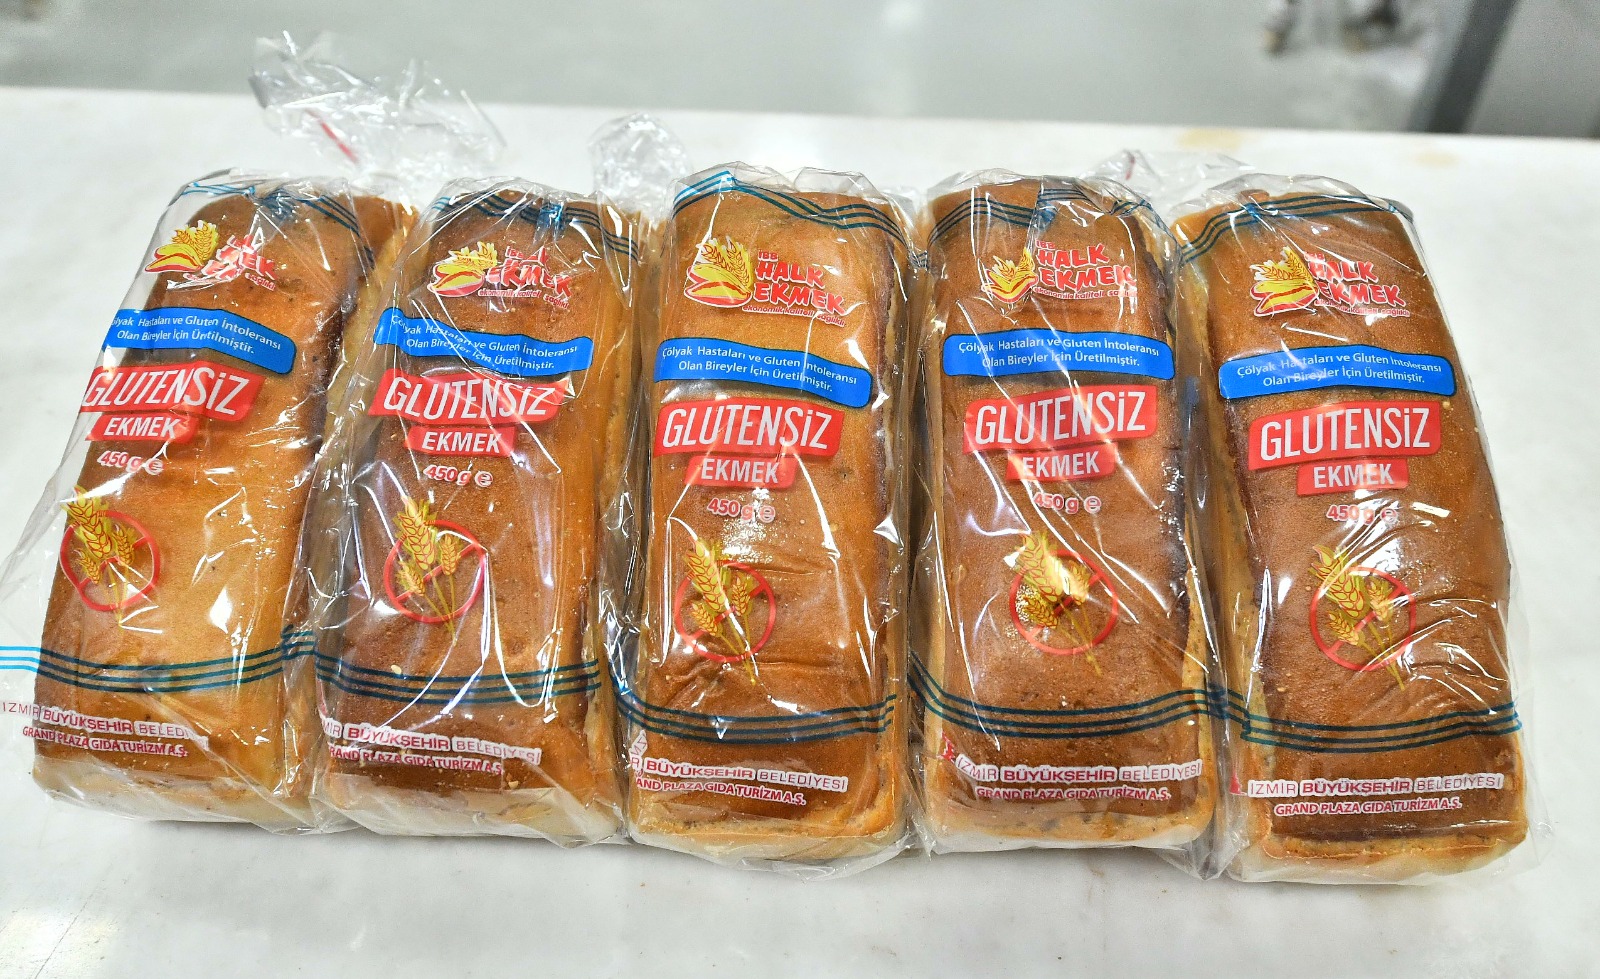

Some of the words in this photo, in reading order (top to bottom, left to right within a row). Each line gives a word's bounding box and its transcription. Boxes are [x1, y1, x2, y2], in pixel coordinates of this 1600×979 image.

[1036, 244, 1109, 269] HALK
[756, 261, 825, 289] HALK
[1039, 265, 1136, 292] EKMEK
[1308, 261, 1378, 283] HALK
[754, 282, 846, 315] EKMEK
[1316, 282, 1406, 307] EKMEK
[111, 316, 134, 327] ölyak
[138, 316, 170, 327] Hastaları
[185, 316, 218, 326] Gluten
[222, 318, 281, 350] İntoleransı
[118, 330, 139, 340] Olan
[142, 331, 171, 342] Bireyler
[406, 339, 428, 348] Olan
[494, 355, 555, 371] Üretilmiştir.
[488, 342, 520, 351] Gluten
[523, 343, 578, 358] İntoleransı
[662, 347, 692, 359] Çölyak
[698, 346, 745, 359] Hastaları
[749, 355, 760, 363] ve
[764, 356, 800, 367] Gluten
[959, 342, 994, 354] Çölyak
[999, 339, 1044, 350] Hastaları
[1063, 338, 1101, 348] Gluten
[1104, 338, 1159, 356] İntoleransı
[982, 357, 1005, 368] Olan
[1008, 354, 1049, 367] Bireyler
[1075, 350, 1140, 367] Üretilmiştir.
[679, 361, 702, 371] Olan
[706, 361, 747, 373] Bireyler
[750, 365, 769, 379] İçin
[1238, 362, 1275, 378] Çölyak
[1353, 353, 1388, 364] Gluten
[1263, 376, 1290, 387] Olan
[1342, 365, 1361, 379] İçin
[1364, 367, 1425, 383] Üretilmiştir.
[104, 417, 180, 439] EKMEK
[422, 432, 502, 454] EKMEK
[701, 458, 780, 484] EKMEK
[1022, 451, 1100, 478] EKMEK
[1314, 464, 1395, 489] EKMEK
[43, 708, 133, 733] BÜYÜKŞEHİR
[23, 726, 55, 741] GRAND
[58, 733, 89, 748] PLAZA
[92, 738, 119, 751] GIDA
[121, 740, 165, 754] TURİZM
[348, 726, 449, 750] BÜYÜKŞEHİR
[363, 752, 400, 763] PLAZA
[404, 756, 434, 768] GIDA
[436, 757, 482, 771] TURİZM
[1004, 768, 1115, 784] BÜYÜKŞEHİR
[1122, 762, 1201, 782] BELEDİYESİ
[646, 760, 753, 779] BÜYÜKŞEHİR
[760, 772, 847, 790] BELEDİYESİ
[1303, 780, 1410, 796] BÜYÜKŞEHİR
[1417, 776, 1501, 792] BELEDİYESİ
[664, 782, 702, 791] PLAZA
[705, 782, 735, 794] GIDA
[736, 785, 782, 801] TURİZM
[784, 793, 806, 806] A.Ş.
[976, 788, 1020, 800] GRAND
[1024, 789, 1063, 800] PLAZA
[1066, 789, 1098, 800] GIDA
[1099, 786, 1146, 800] TURİZM
[1276, 802, 1318, 815] GRAND
[1322, 802, 1359, 814] PLAZA
[1363, 802, 1392, 813] GIDA
[1394, 798, 1437, 812] TURİZM
